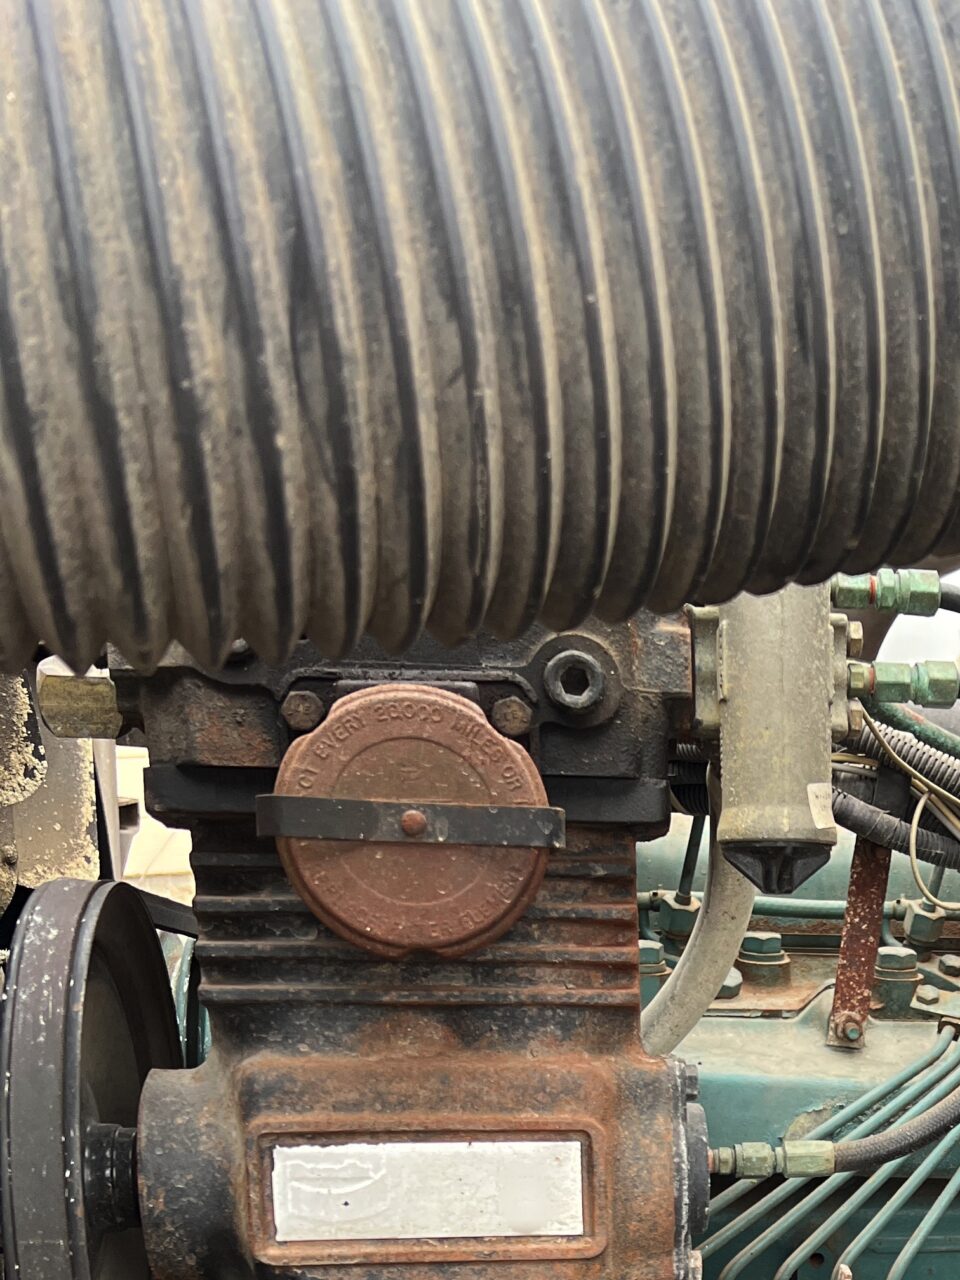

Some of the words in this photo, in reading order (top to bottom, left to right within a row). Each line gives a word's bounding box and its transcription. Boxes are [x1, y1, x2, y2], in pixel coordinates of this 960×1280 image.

[313, 710, 367, 760] EVERY
[450, 711, 505, 763] MILES
[501, 765, 523, 791] OR
